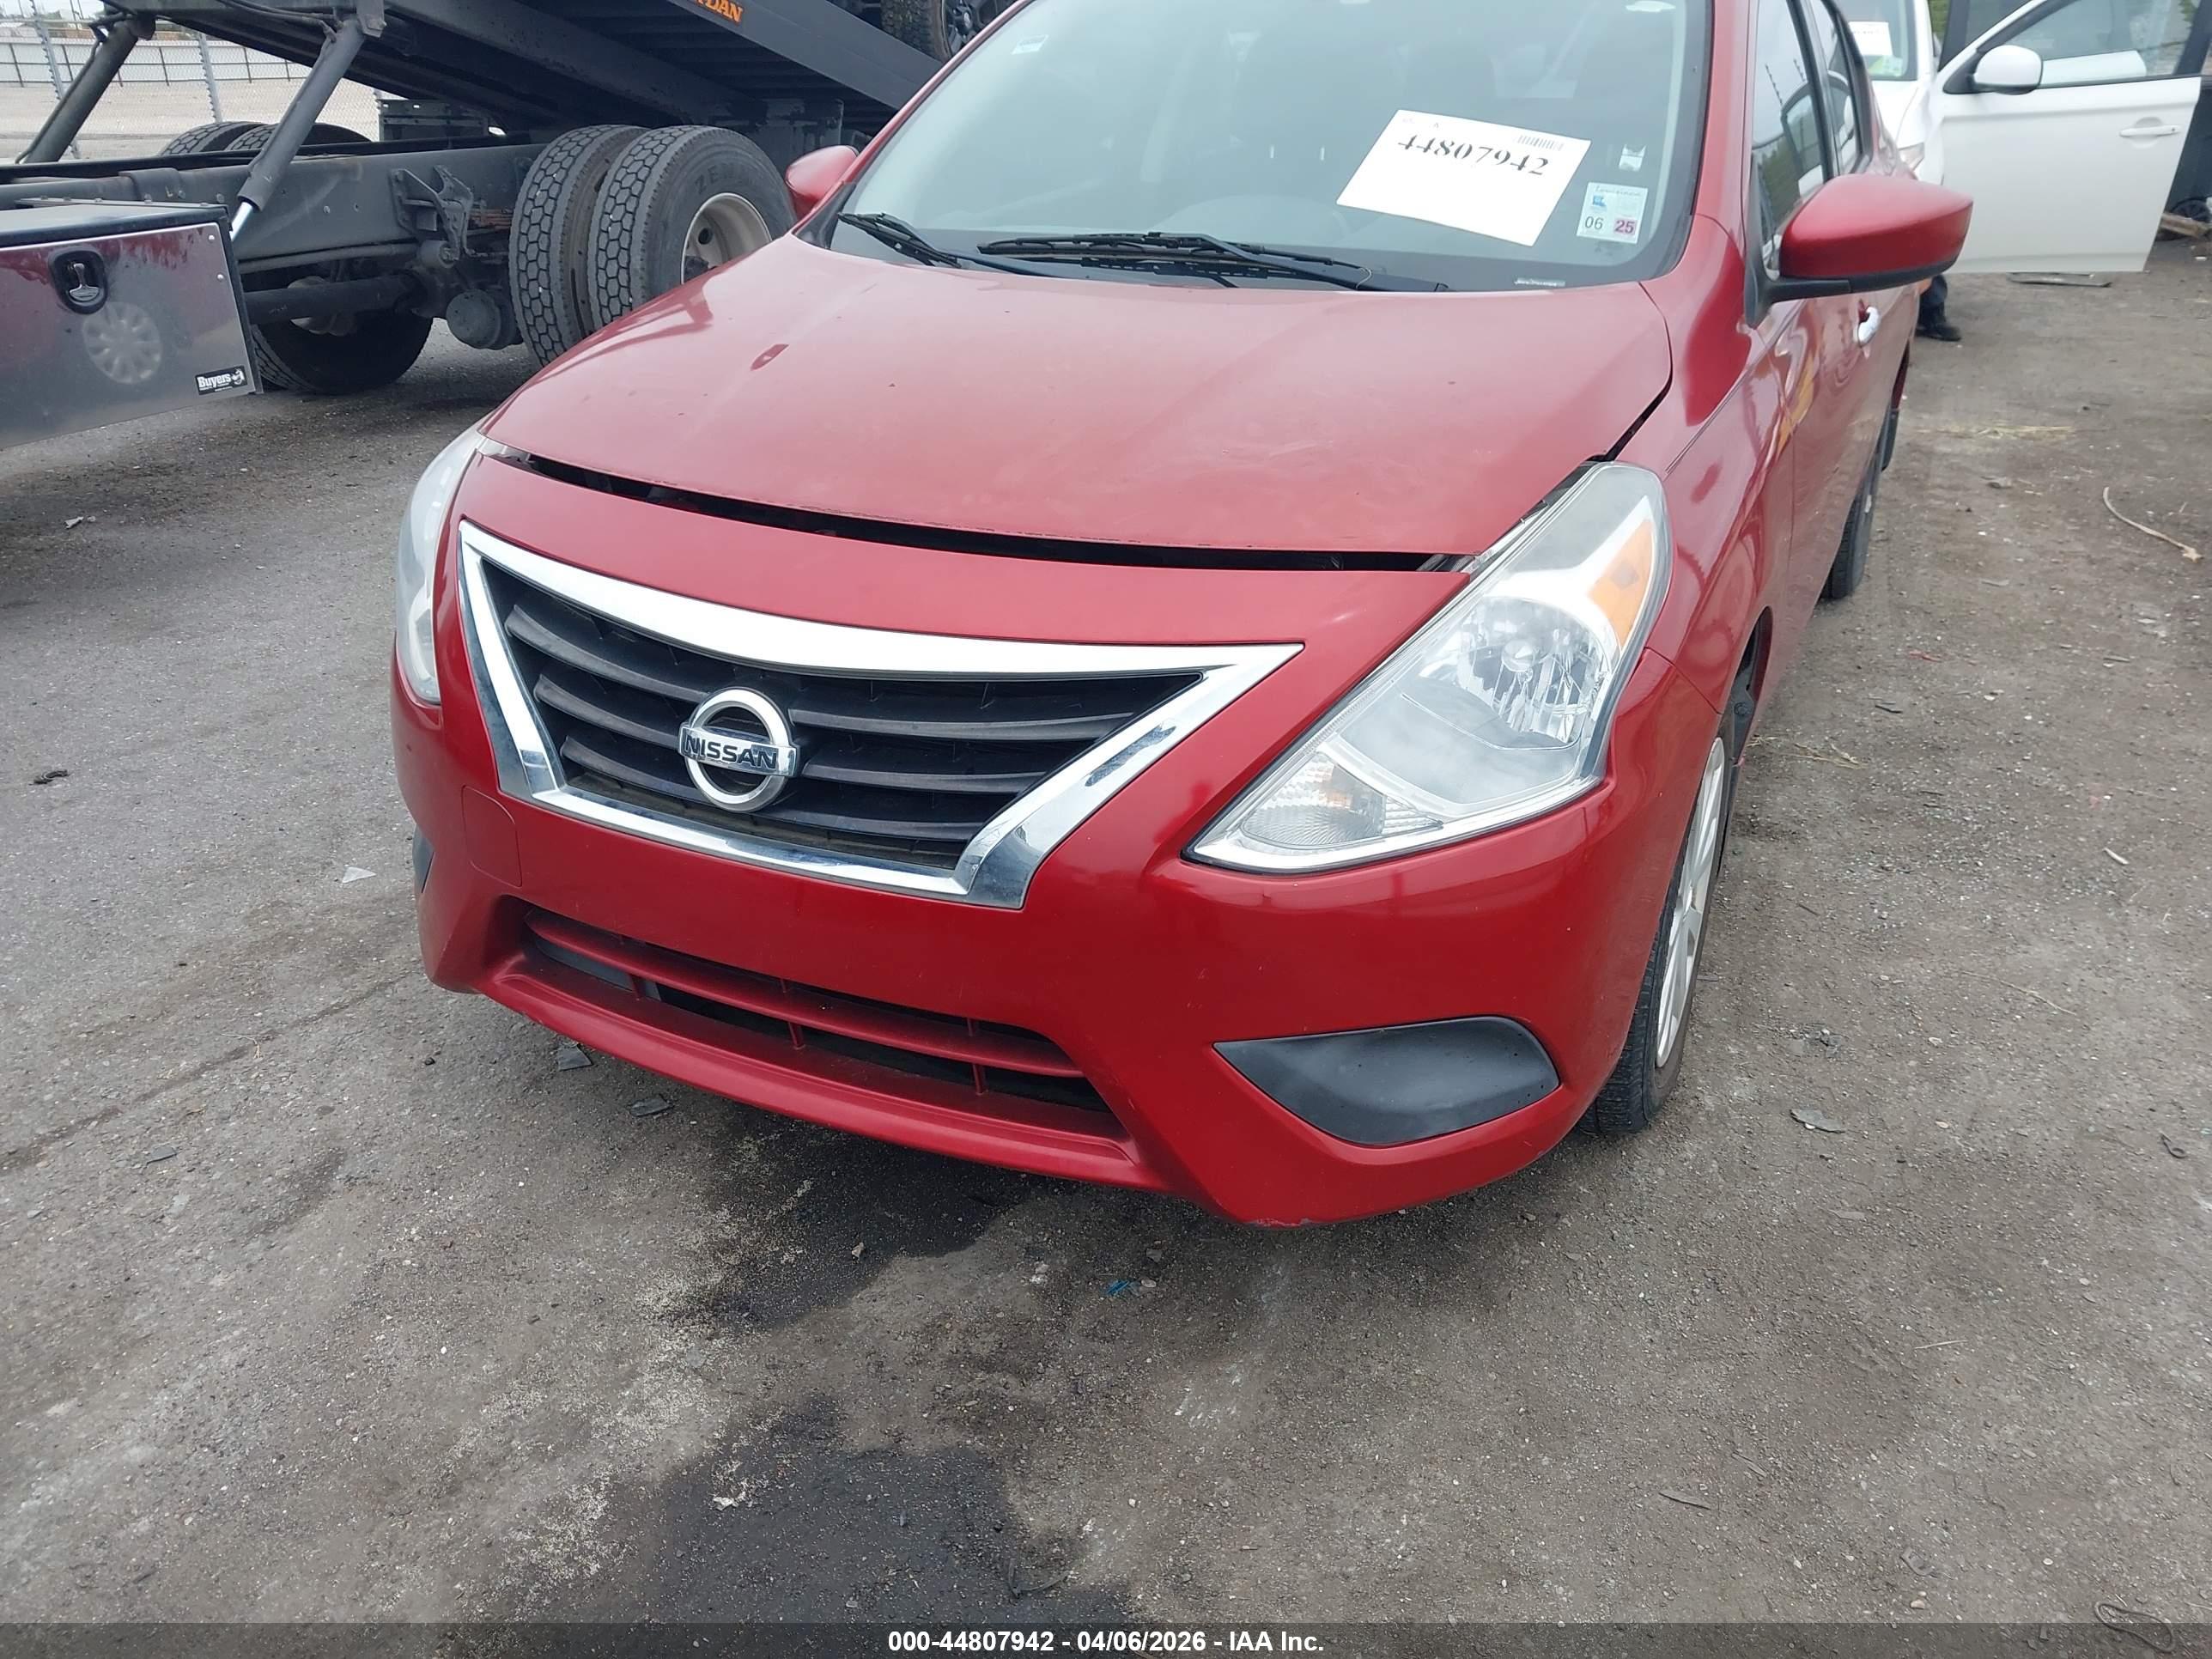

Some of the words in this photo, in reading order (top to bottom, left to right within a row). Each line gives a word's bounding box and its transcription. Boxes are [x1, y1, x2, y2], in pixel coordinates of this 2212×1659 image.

[697, 0, 744, 23] DAN
[1398, 135, 1548, 175] 44807942
[1584, 216, 1603, 230] 06
[1614, 219, 1635, 234] 25
[198, 374, 231, 387] Buyers
[685, 734, 777, 769] NISSAN
